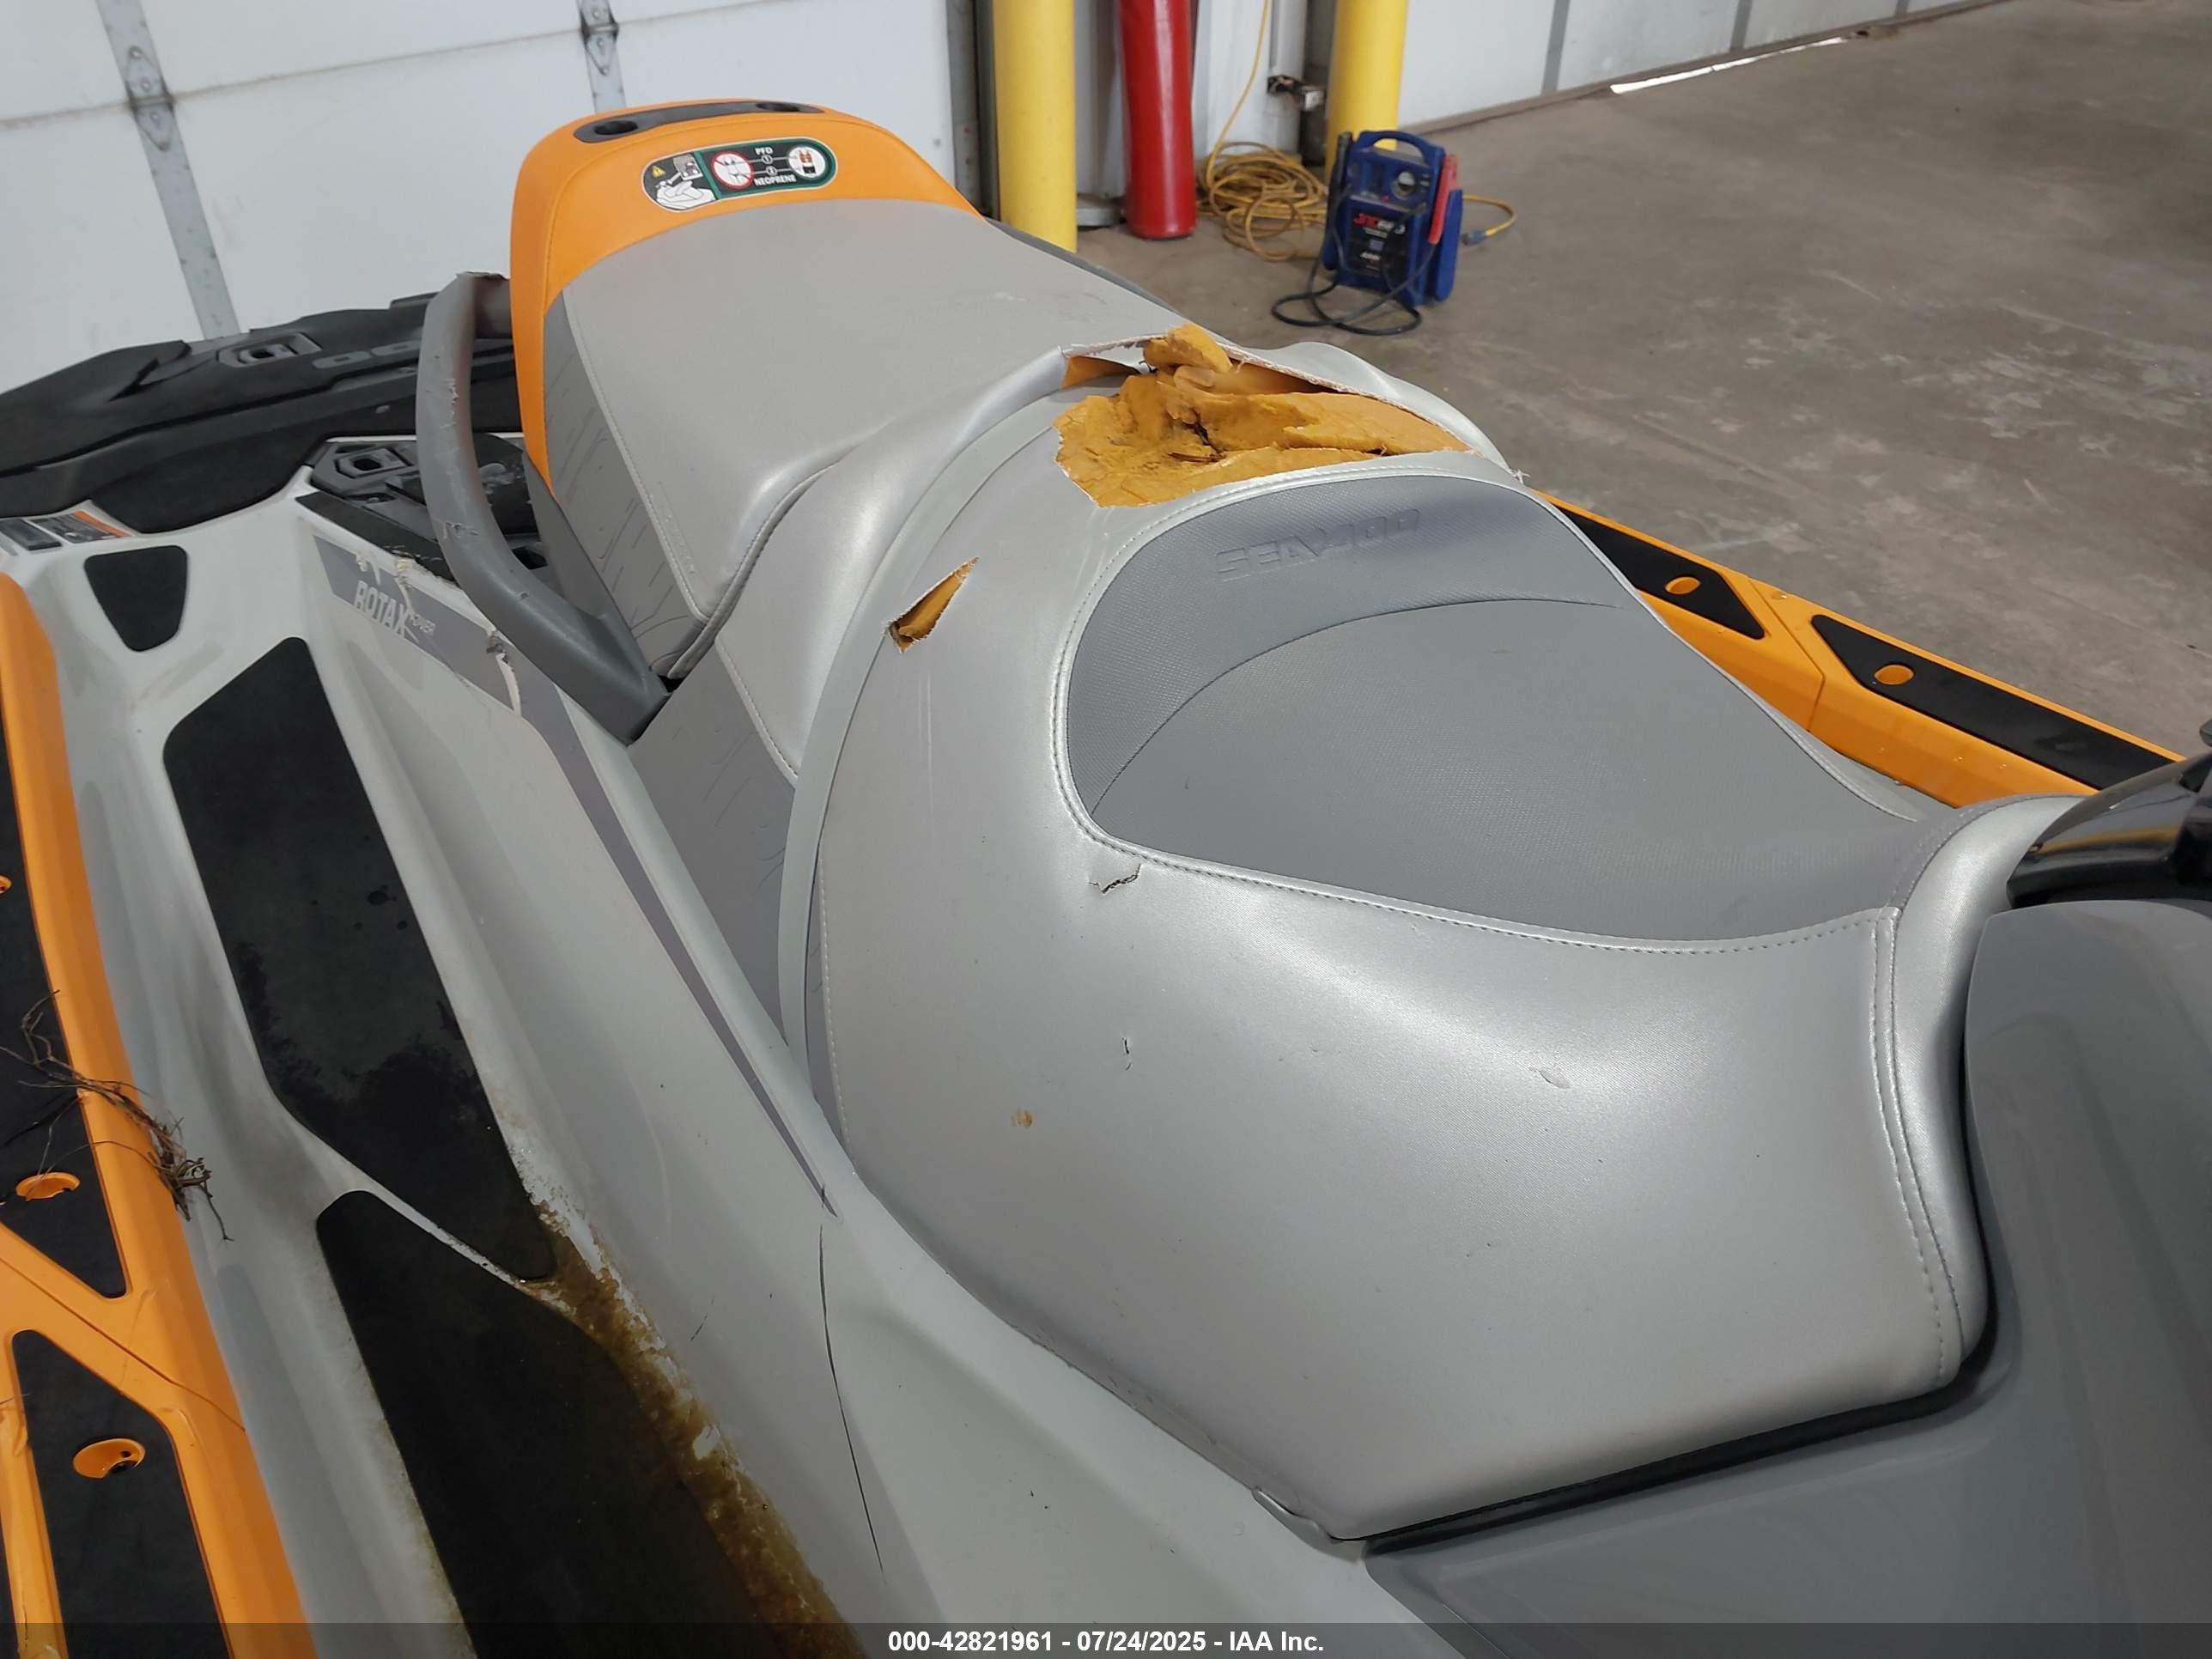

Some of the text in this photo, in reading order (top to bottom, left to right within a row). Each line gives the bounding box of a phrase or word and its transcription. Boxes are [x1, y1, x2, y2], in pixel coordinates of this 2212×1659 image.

[755, 147, 774, 155] PFD
[754, 174, 797, 186] NEOPRENE
[354, 580, 419, 643] ROTAX
